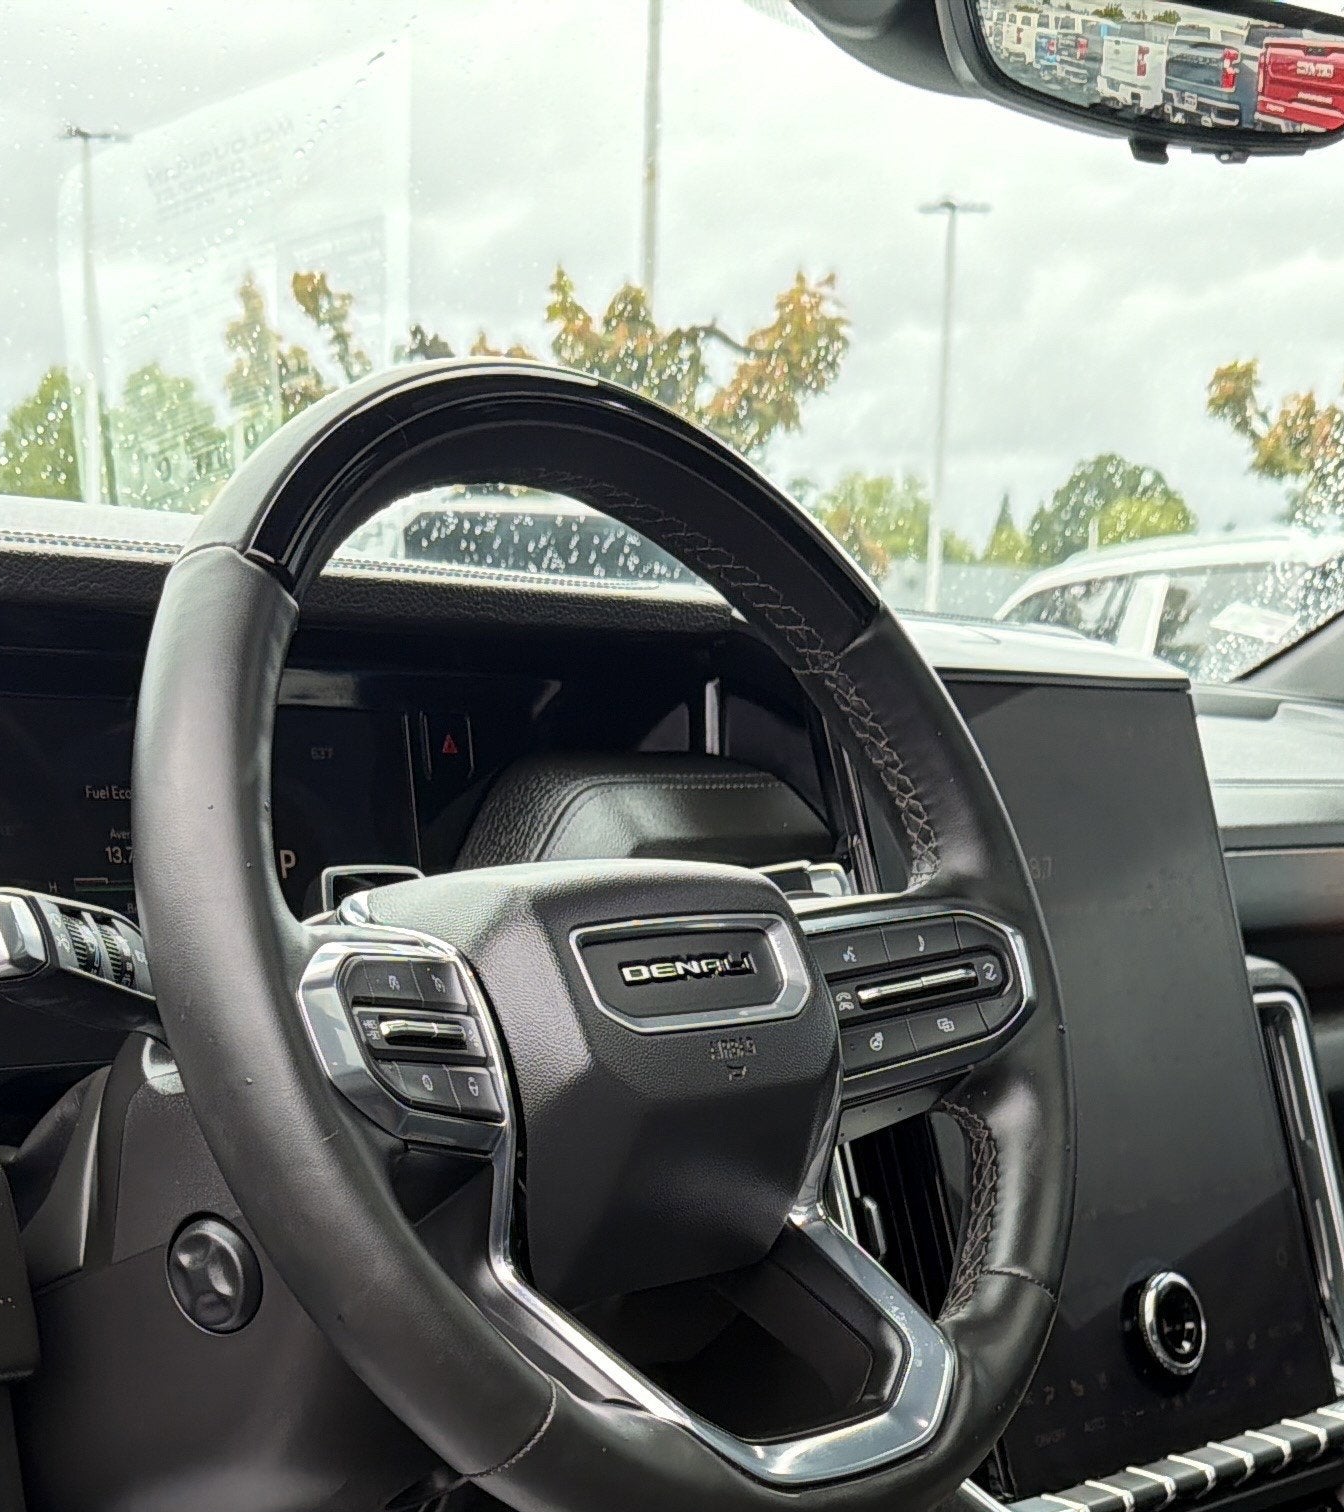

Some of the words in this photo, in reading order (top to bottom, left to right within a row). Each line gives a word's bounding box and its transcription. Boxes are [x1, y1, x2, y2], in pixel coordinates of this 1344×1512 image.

[85, 785, 109, 799] Fuel
[279, 849, 296, 879] P
[619, 951, 758, 985] DENALI
